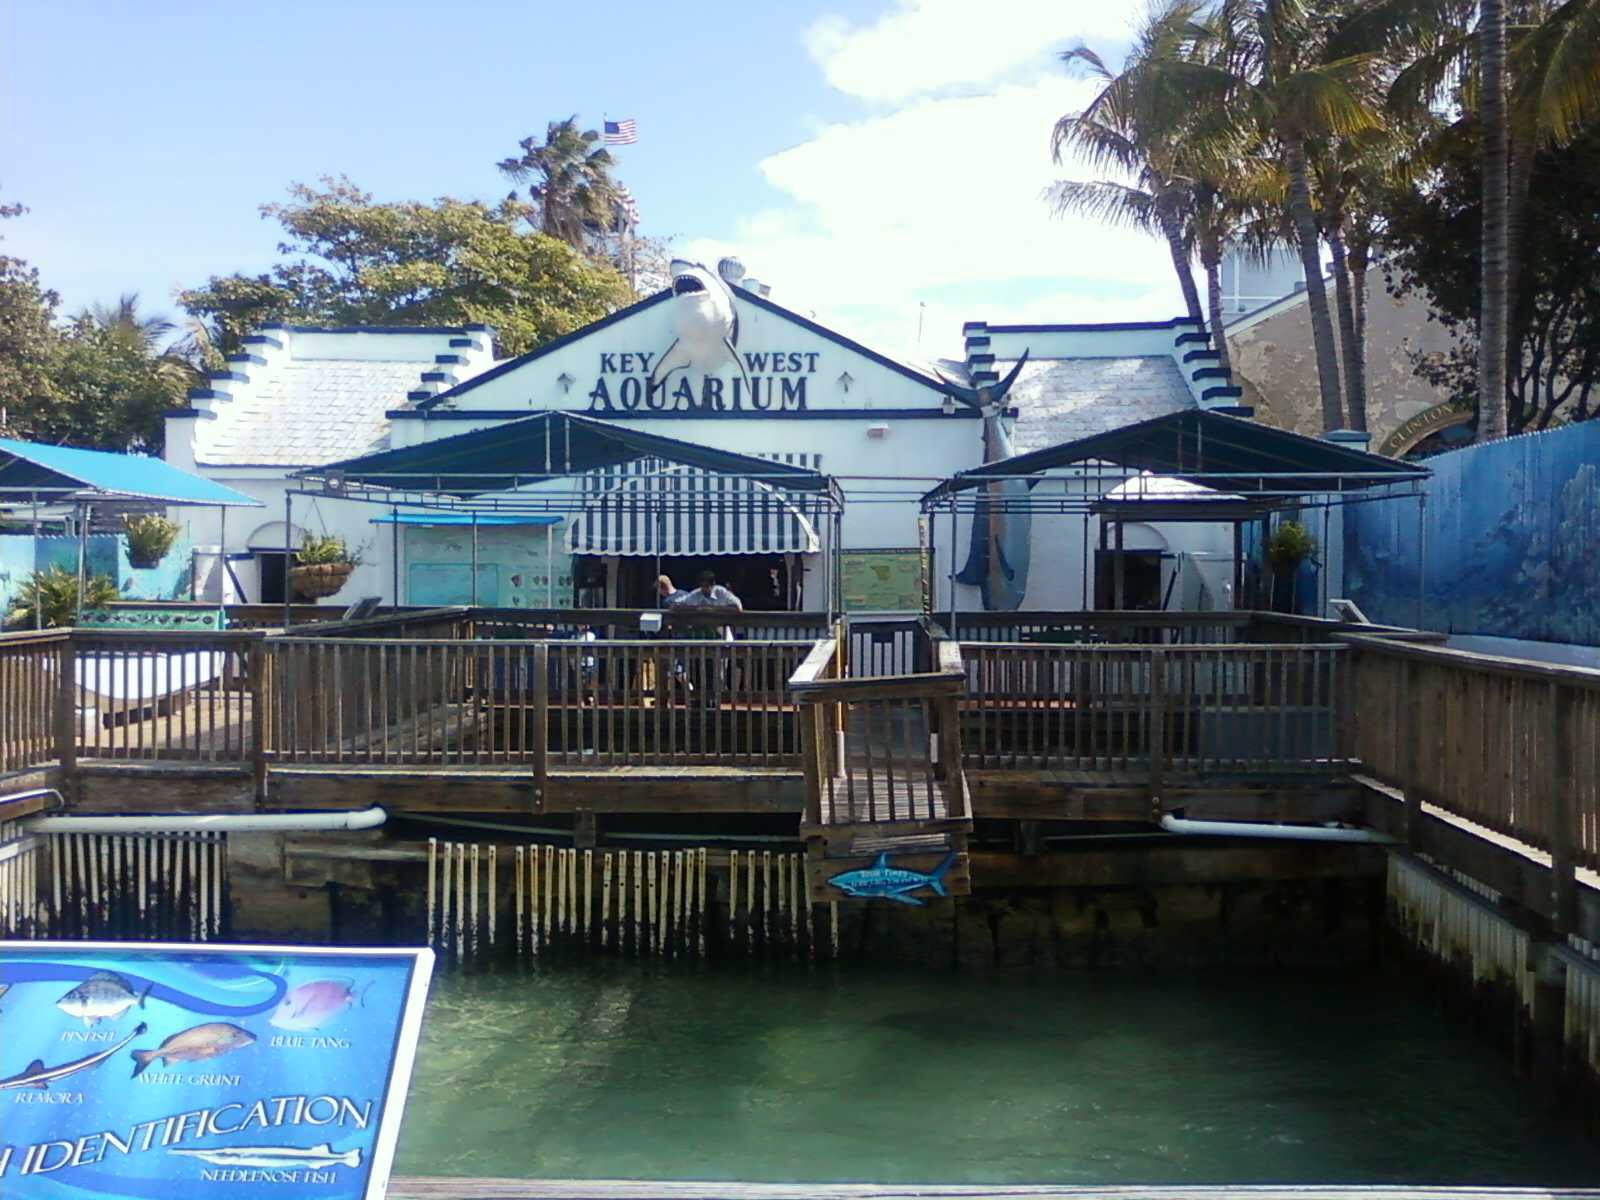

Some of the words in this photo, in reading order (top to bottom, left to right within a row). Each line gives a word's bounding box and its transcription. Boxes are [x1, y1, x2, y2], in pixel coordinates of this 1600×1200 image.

[600, 352, 655, 373] KEY
[743, 352, 820, 373] WEST
[588, 375, 808, 411] AQUARIUM
[270, 1035, 304, 1048] BLUE
[311, 1036, 353, 1049] TANG
[138, 1072, 184, 1085] WHITE
[188, 1073, 241, 1087] GRUNT
[15, 1091, 84, 1105] REMORA
[20, 1094, 373, 1176] IDENTIFICATION
[200, 1167, 300, 1183] NEEDLENOSE
[303, 1170, 337, 1184] FISH
